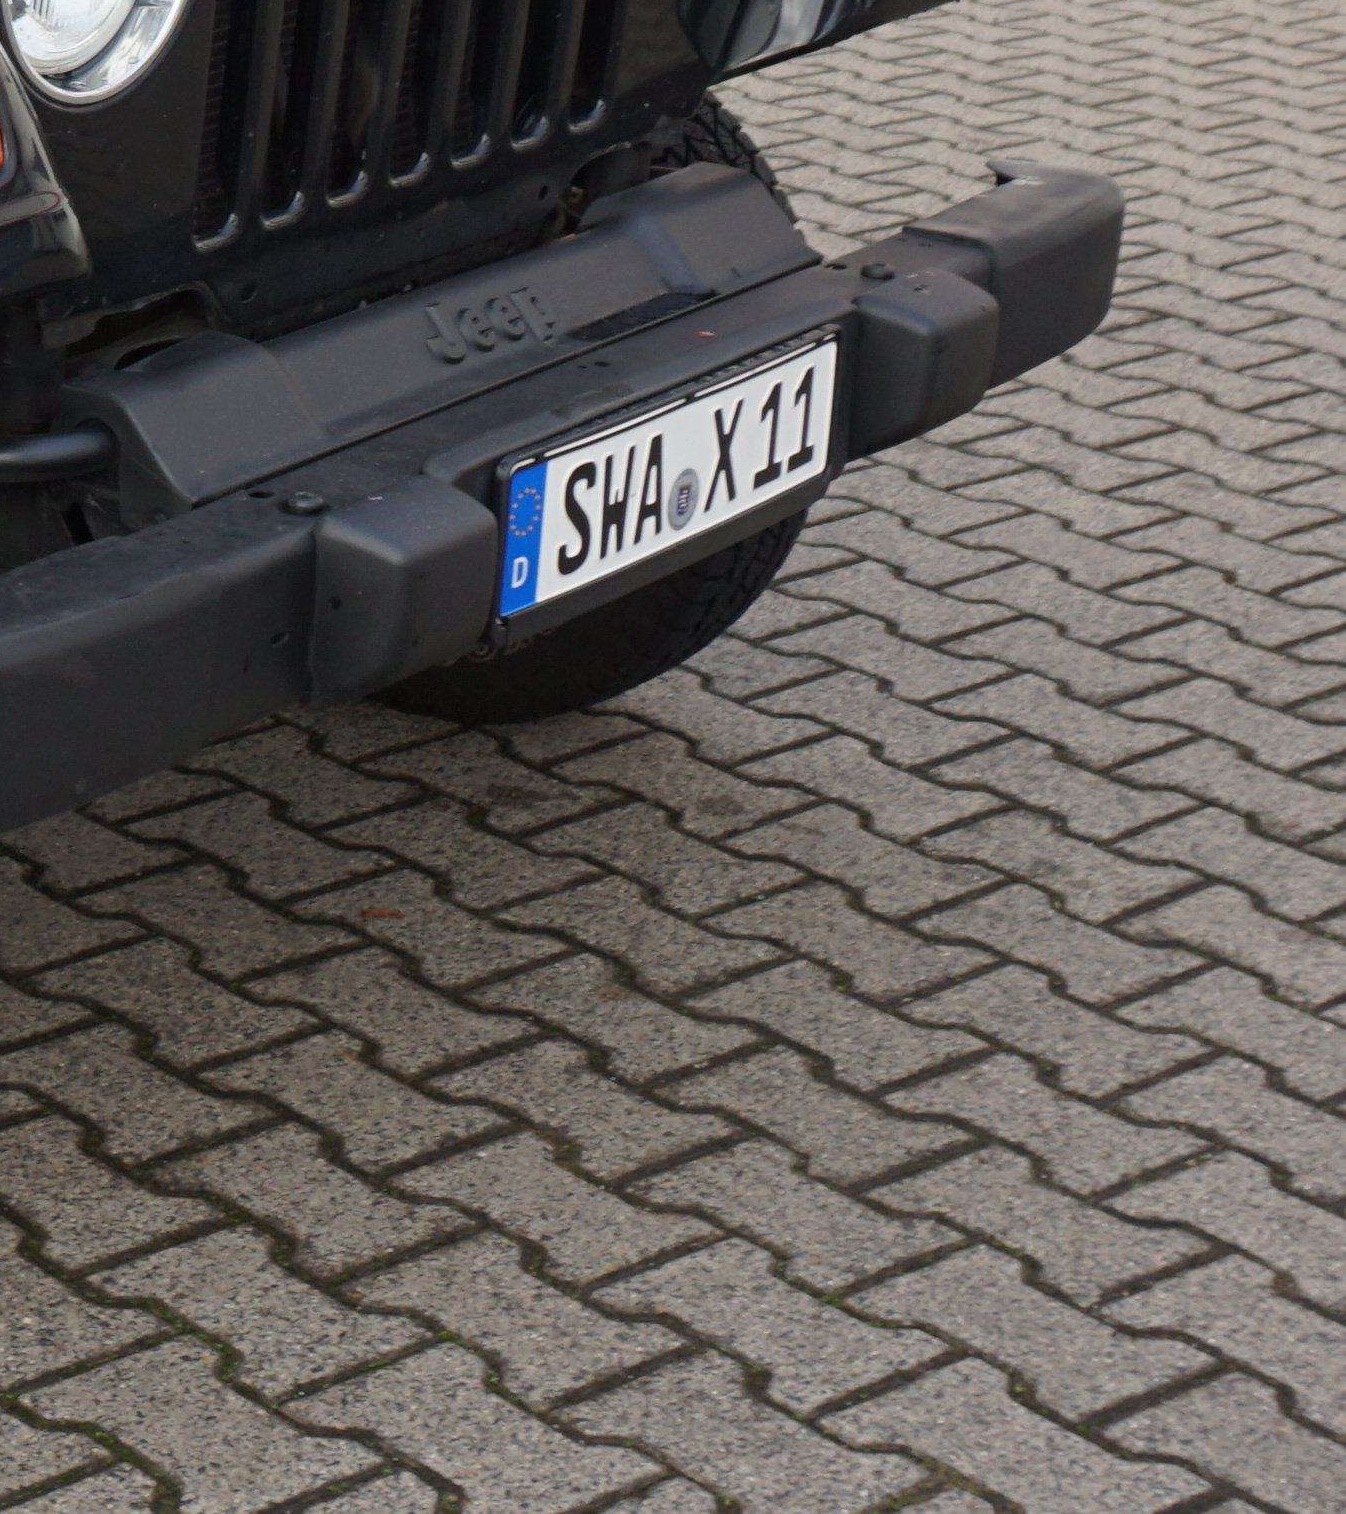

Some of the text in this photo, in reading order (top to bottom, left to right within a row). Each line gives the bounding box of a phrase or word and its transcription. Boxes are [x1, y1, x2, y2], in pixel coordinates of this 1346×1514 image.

[424, 286, 558, 365] Jeep
[557, 365, 816, 576] SWA X 11
[512, 556, 529, 590] D
